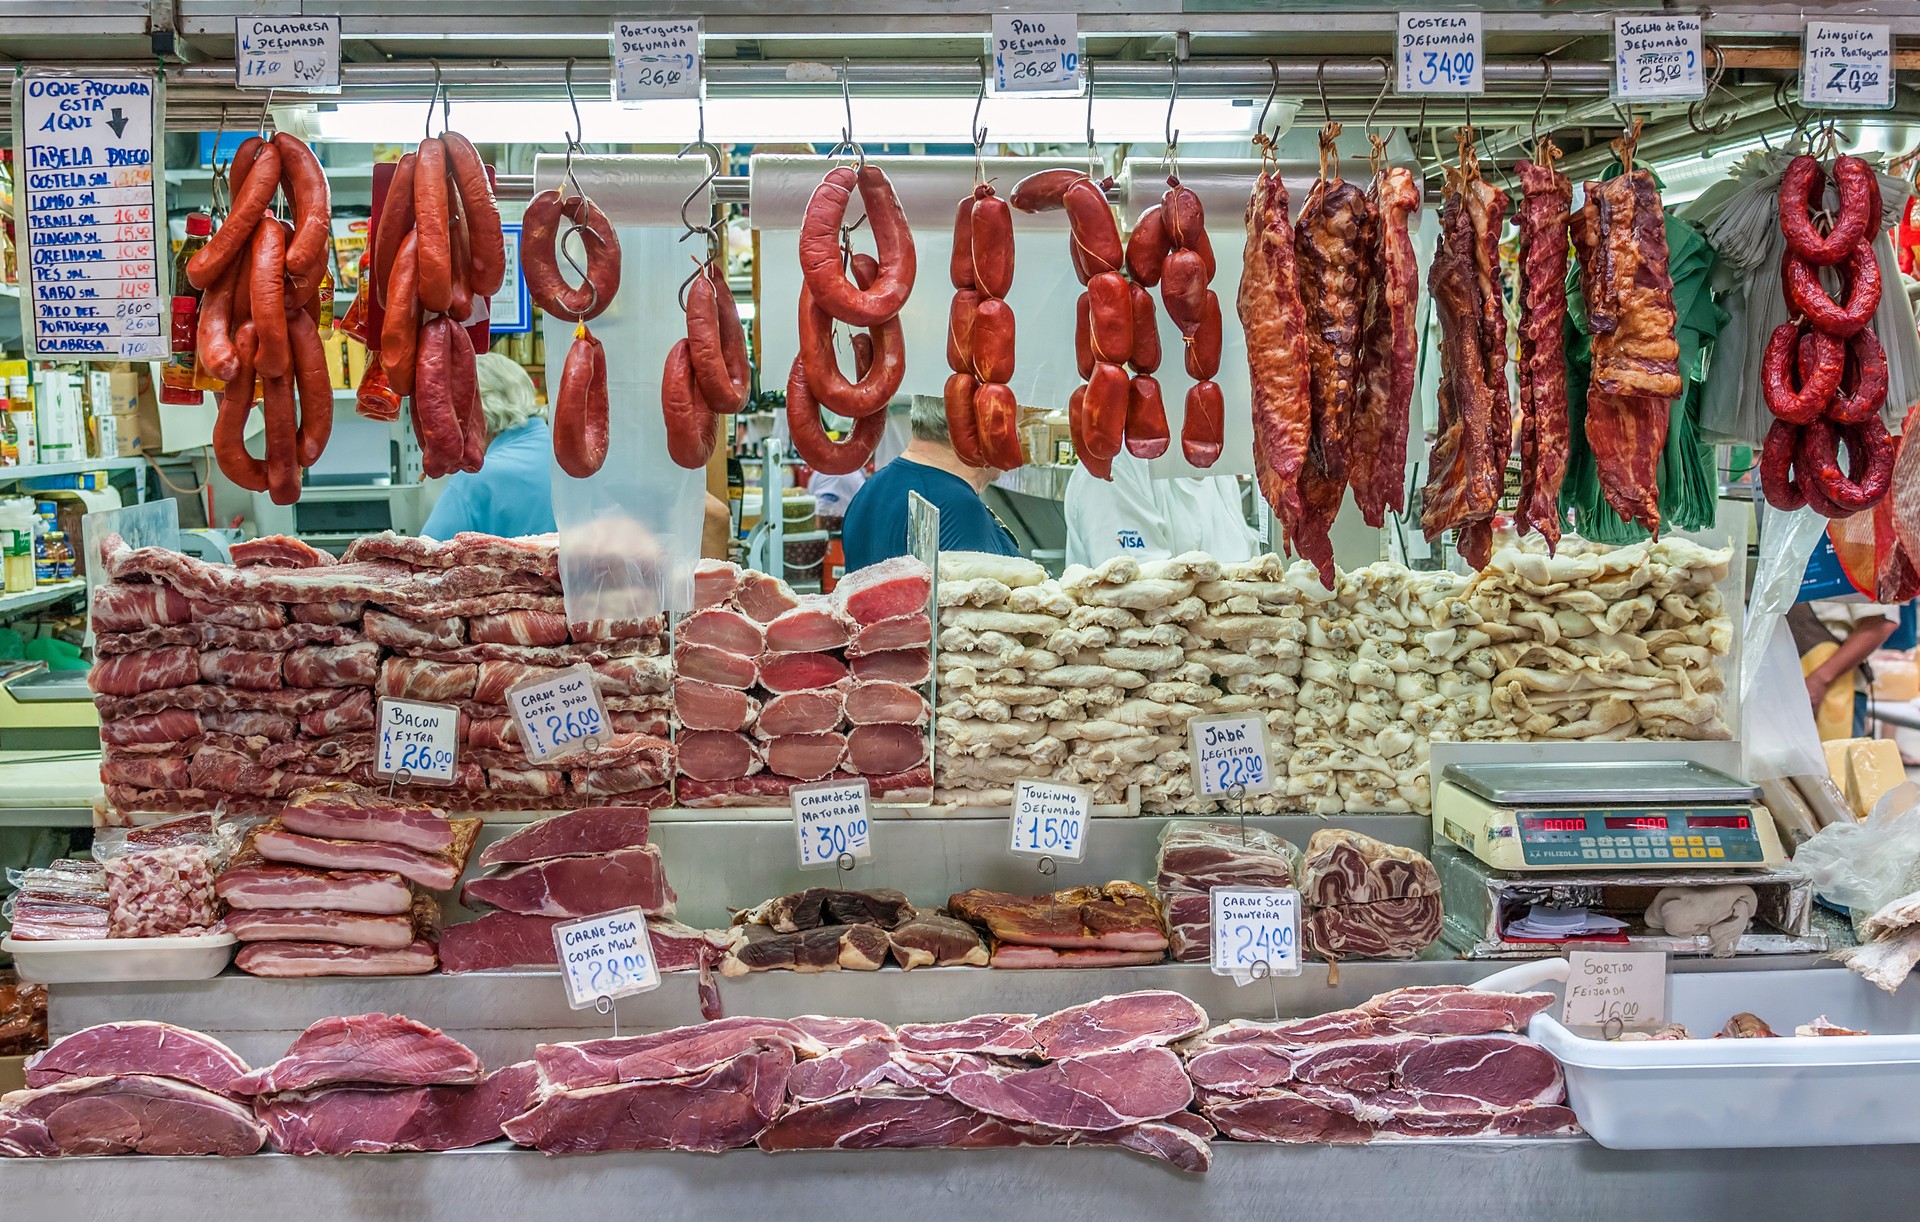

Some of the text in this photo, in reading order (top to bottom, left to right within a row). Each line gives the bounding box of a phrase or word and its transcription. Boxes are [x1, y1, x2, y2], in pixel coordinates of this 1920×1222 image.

[1011, 19, 1046, 35] PAIO
[1407, 18, 1466, 29] COSTELA
[1620, 21, 1661, 36] JOELHO
[996, 52, 1006, 88] KILO
[1418, 51, 1475, 86] 34,00
[1639, 64, 1681, 84] 25,00
[638, 67, 681, 89] 26,00
[1826, 68, 1879, 94] 40,00
[29, 80, 150, 97] O QUE PROCURA
[60, 96, 107, 111] ESTÁ
[39, 112, 93, 132] AQUI
[30, 172, 86, 188] COSTELA
[32, 194, 74, 211] LOMBO
[29, 214, 77, 228] PERNIL
[33, 231, 83, 245] LINGUA
[34, 248, 86, 264] ORELHA
[33, 262, 61, 281] PÉS
[38, 285, 76, 301] RABO
[39, 304, 71, 318] PAIO
[39, 320, 110, 336] PORTUGUESA
[1116, 536, 1145, 549] VISA
[525, 695, 587, 719] COXÃO DURO
[388, 707, 439, 728] BACON
[546, 707, 601, 746] 26,00
[395, 730, 433, 743] EXTRA
[401, 743, 452, 770] 26,00
[1738, 817, 1748, 830] 0
[816, 819, 867, 859] 30,00
[1029, 816, 1079, 850] 15,00
[801, 826, 809, 861] KILO
[1235, 924, 1293, 964] 24,00
[568, 944, 604, 963] COXÃO
[588, 954, 647, 993] 28,00
[1584, 958, 1633, 975] SORTIDO
[1596, 976, 1609, 985] DE
[1572, 985, 1625, 997] FEIJOADA
